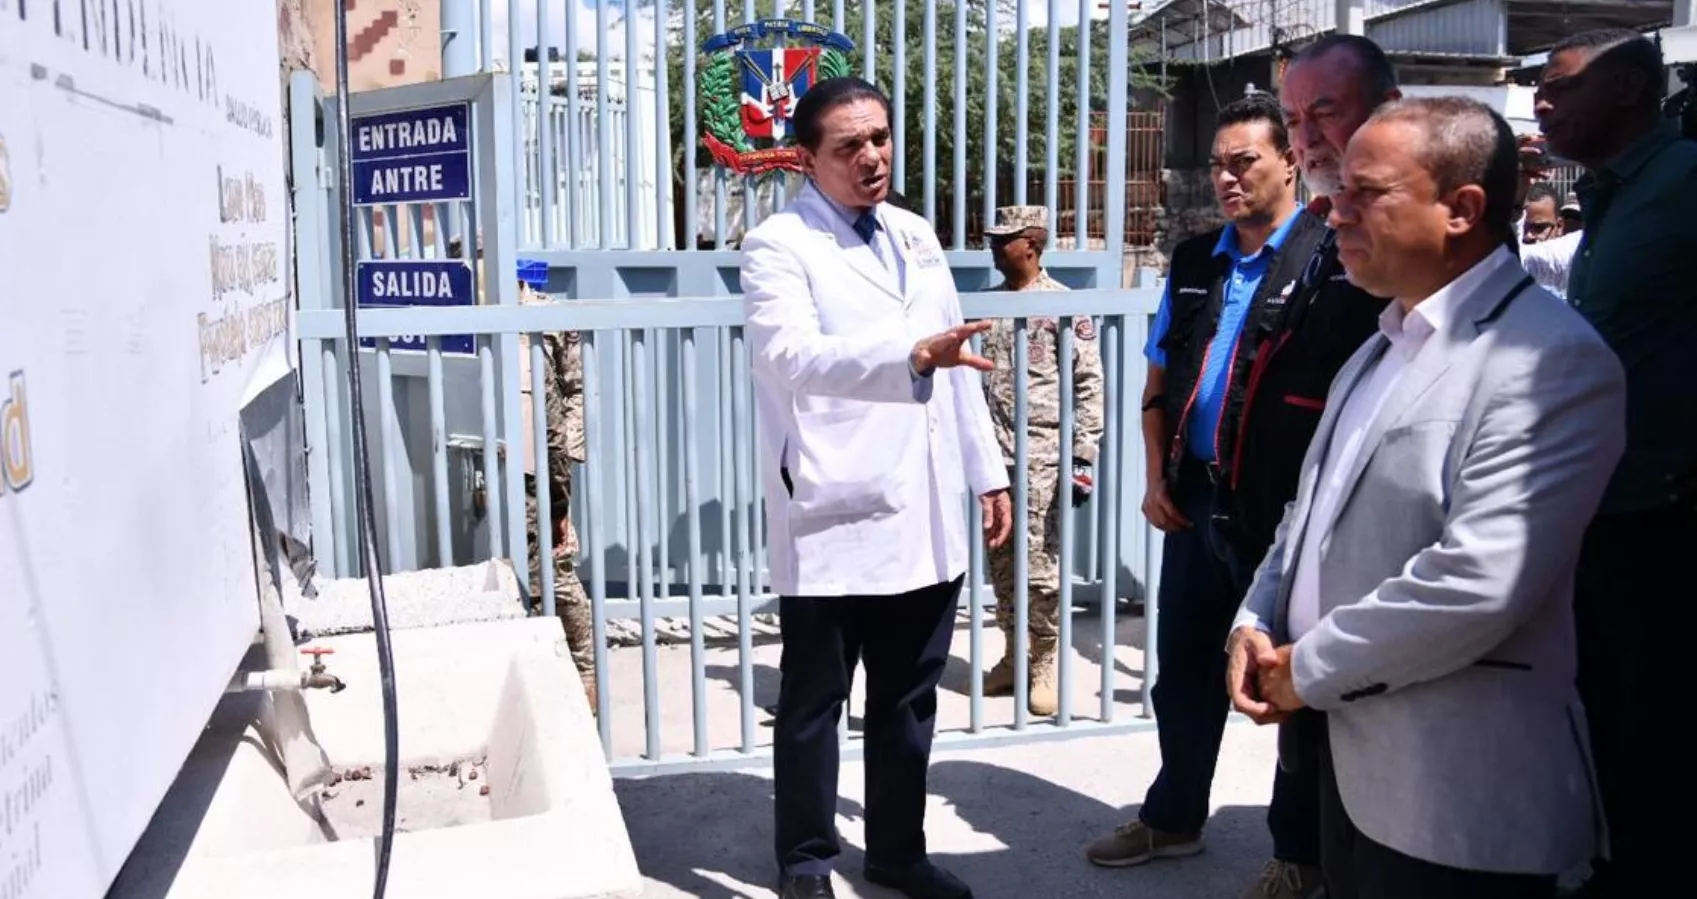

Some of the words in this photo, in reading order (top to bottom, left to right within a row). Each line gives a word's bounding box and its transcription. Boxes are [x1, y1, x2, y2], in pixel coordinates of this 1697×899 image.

[358, 116, 458, 152] ENTRADA
[371, 164, 444, 195] ANTRE
[372, 271, 453, 298] SALIDA
